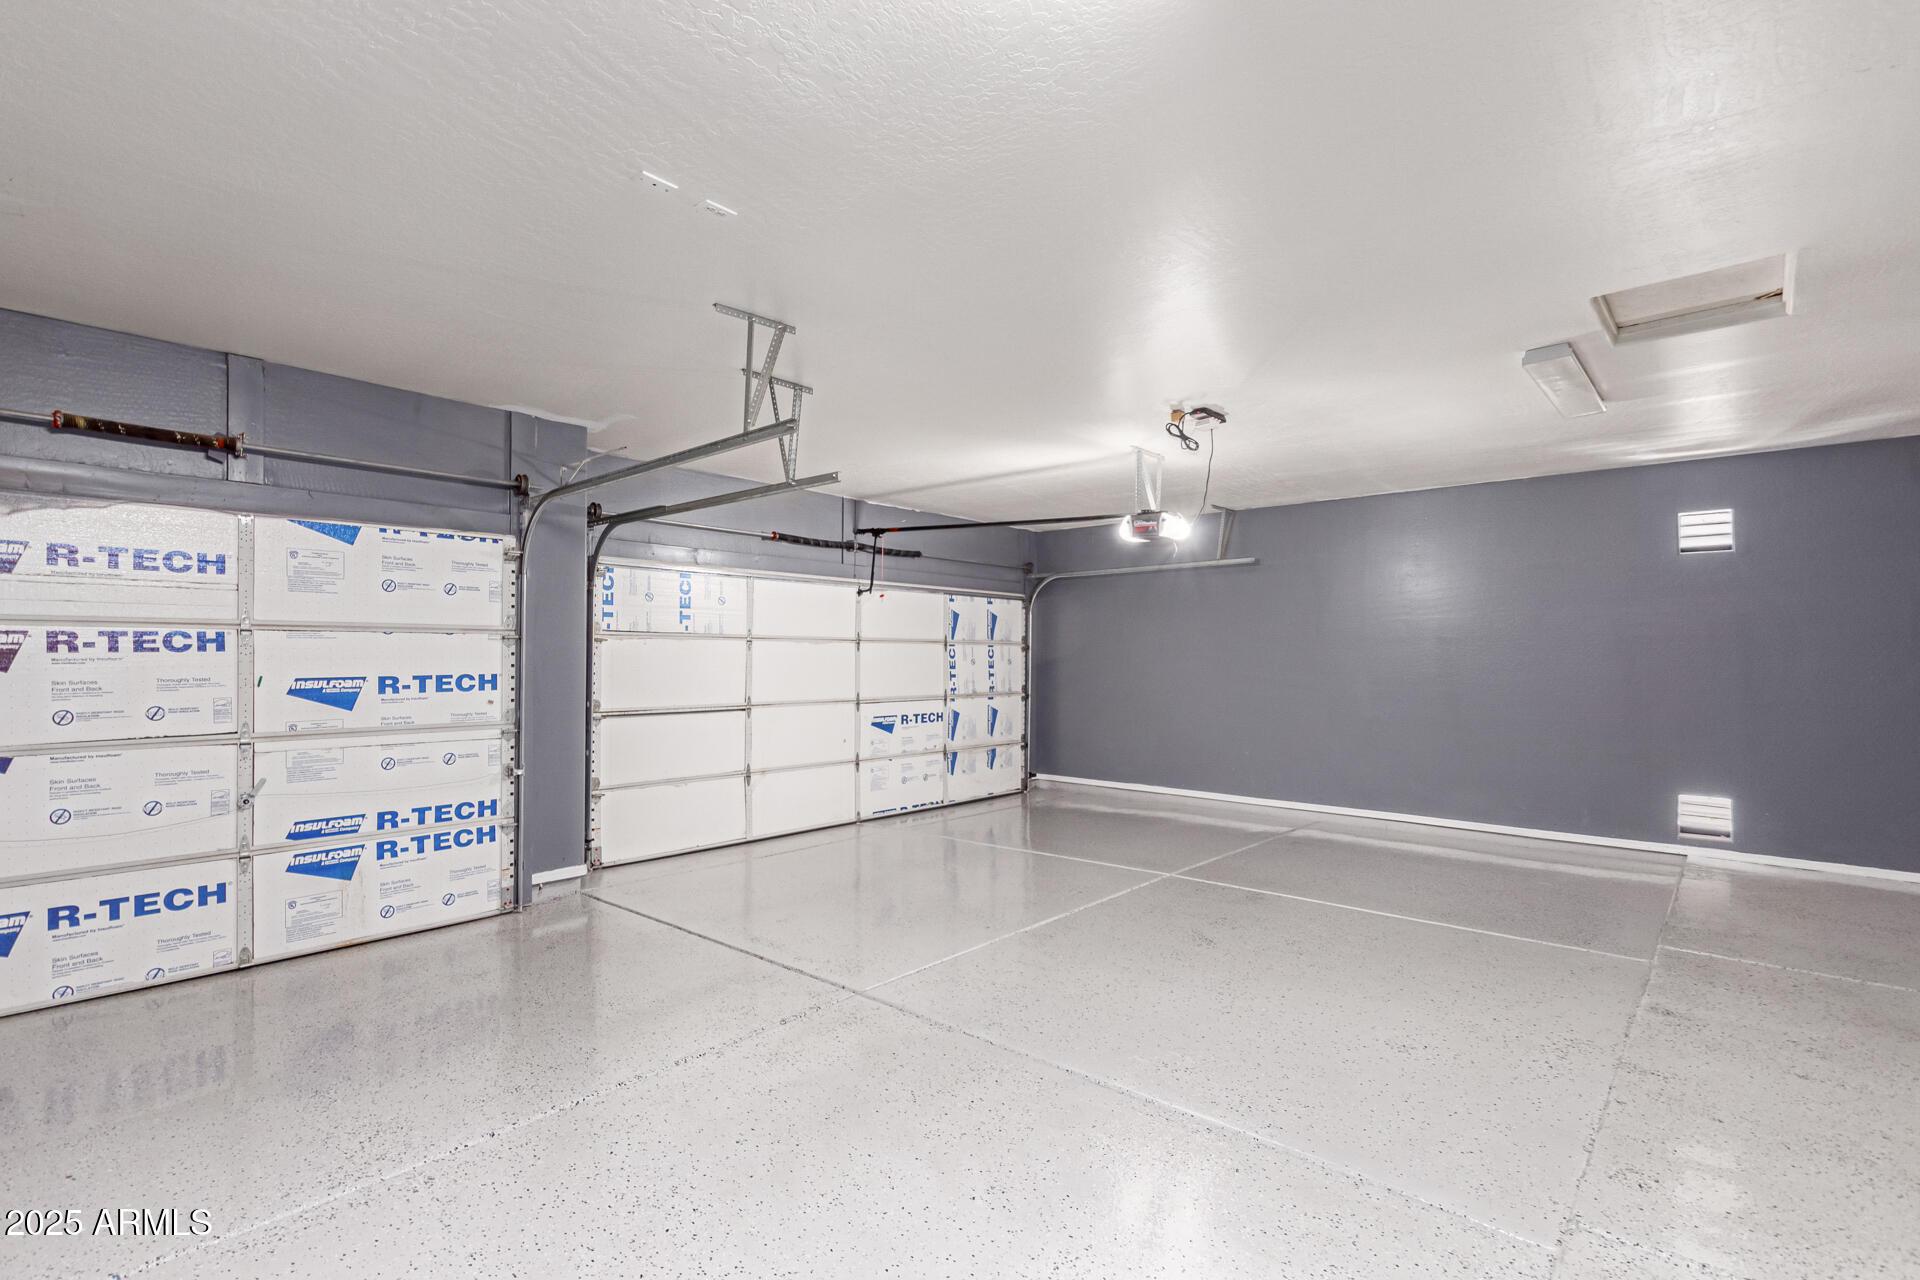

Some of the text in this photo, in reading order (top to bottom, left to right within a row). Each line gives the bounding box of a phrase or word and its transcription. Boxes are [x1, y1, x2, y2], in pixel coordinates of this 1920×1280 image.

[46, 542, 225, 575] R-TECH
[46, 630, 226, 653] R-TECH
[377, 673, 498, 695] R-TECH
[900, 712, 944, 725] R-TECH
[376, 799, 498, 831] R-TECH
[376, 825, 496, 861] R-TECH
[48, 882, 226, 931] R-TECH
